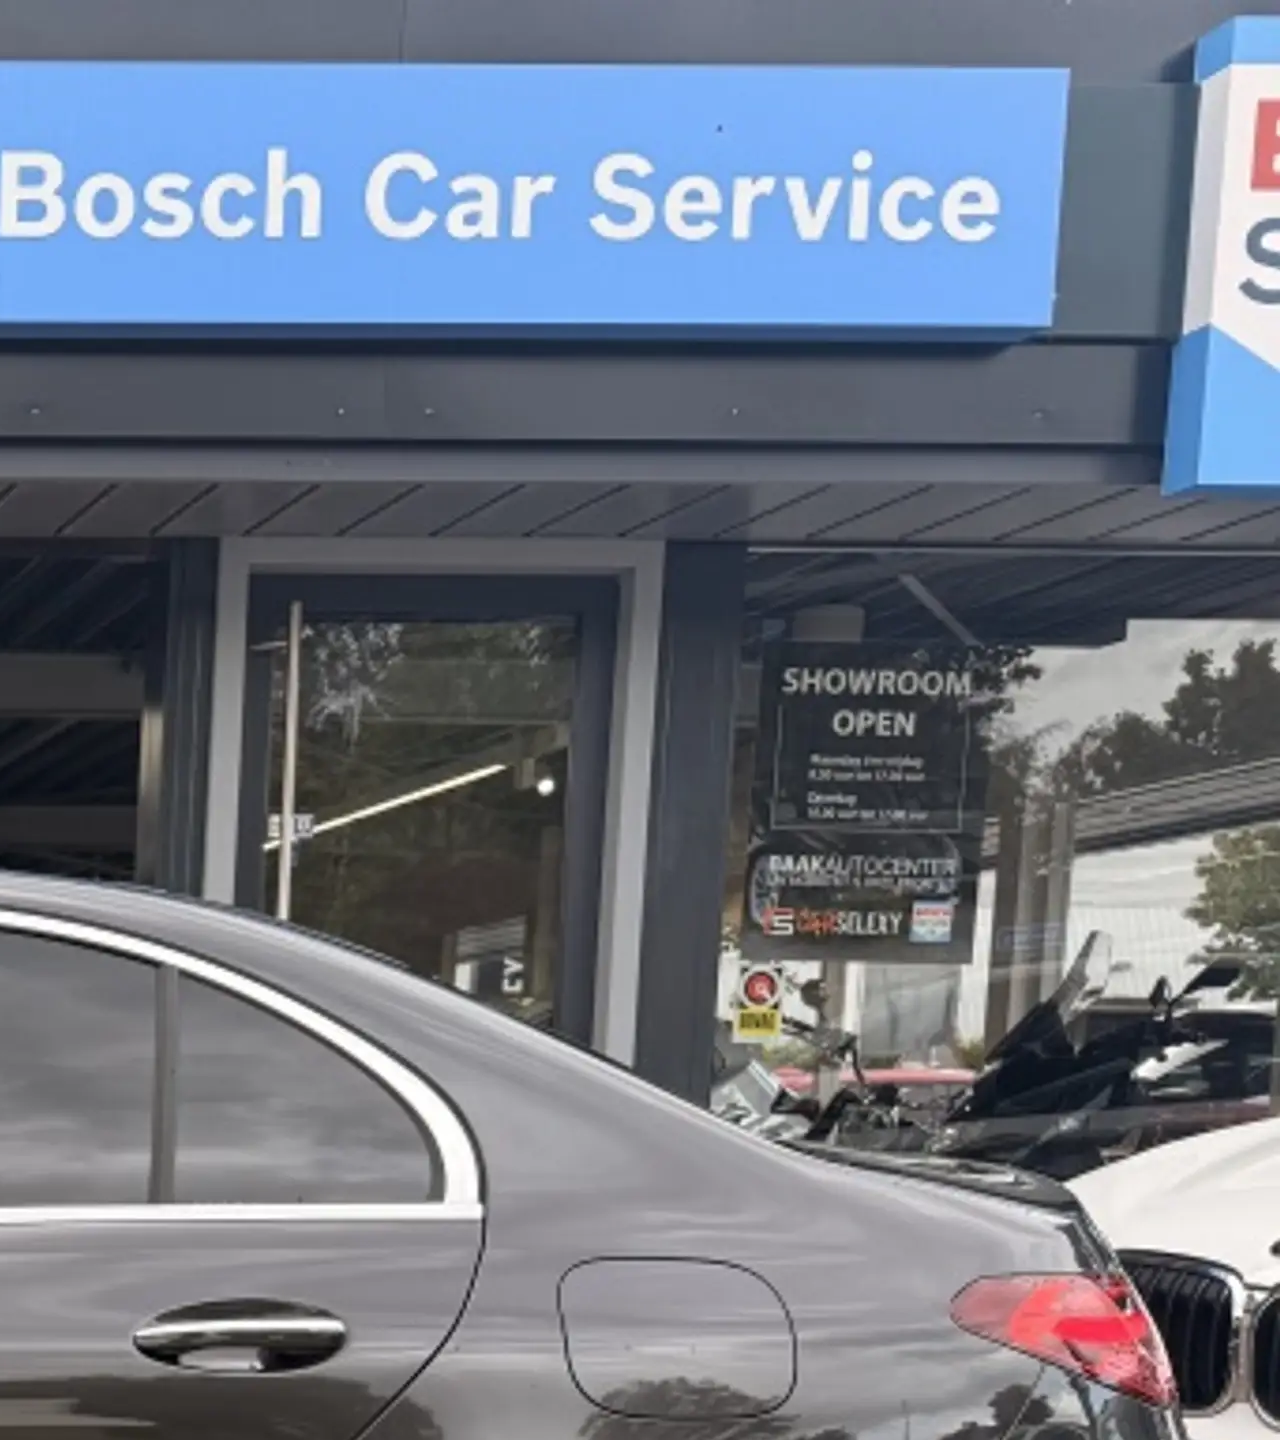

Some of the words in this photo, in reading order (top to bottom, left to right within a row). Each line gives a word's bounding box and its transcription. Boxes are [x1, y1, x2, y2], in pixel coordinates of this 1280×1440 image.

[364, 150, 557, 240] Car
[589, 149, 1001, 243] Service
[781, 667, 973, 696] SHOWROOM
[832, 708, 918, 736] OPEN
